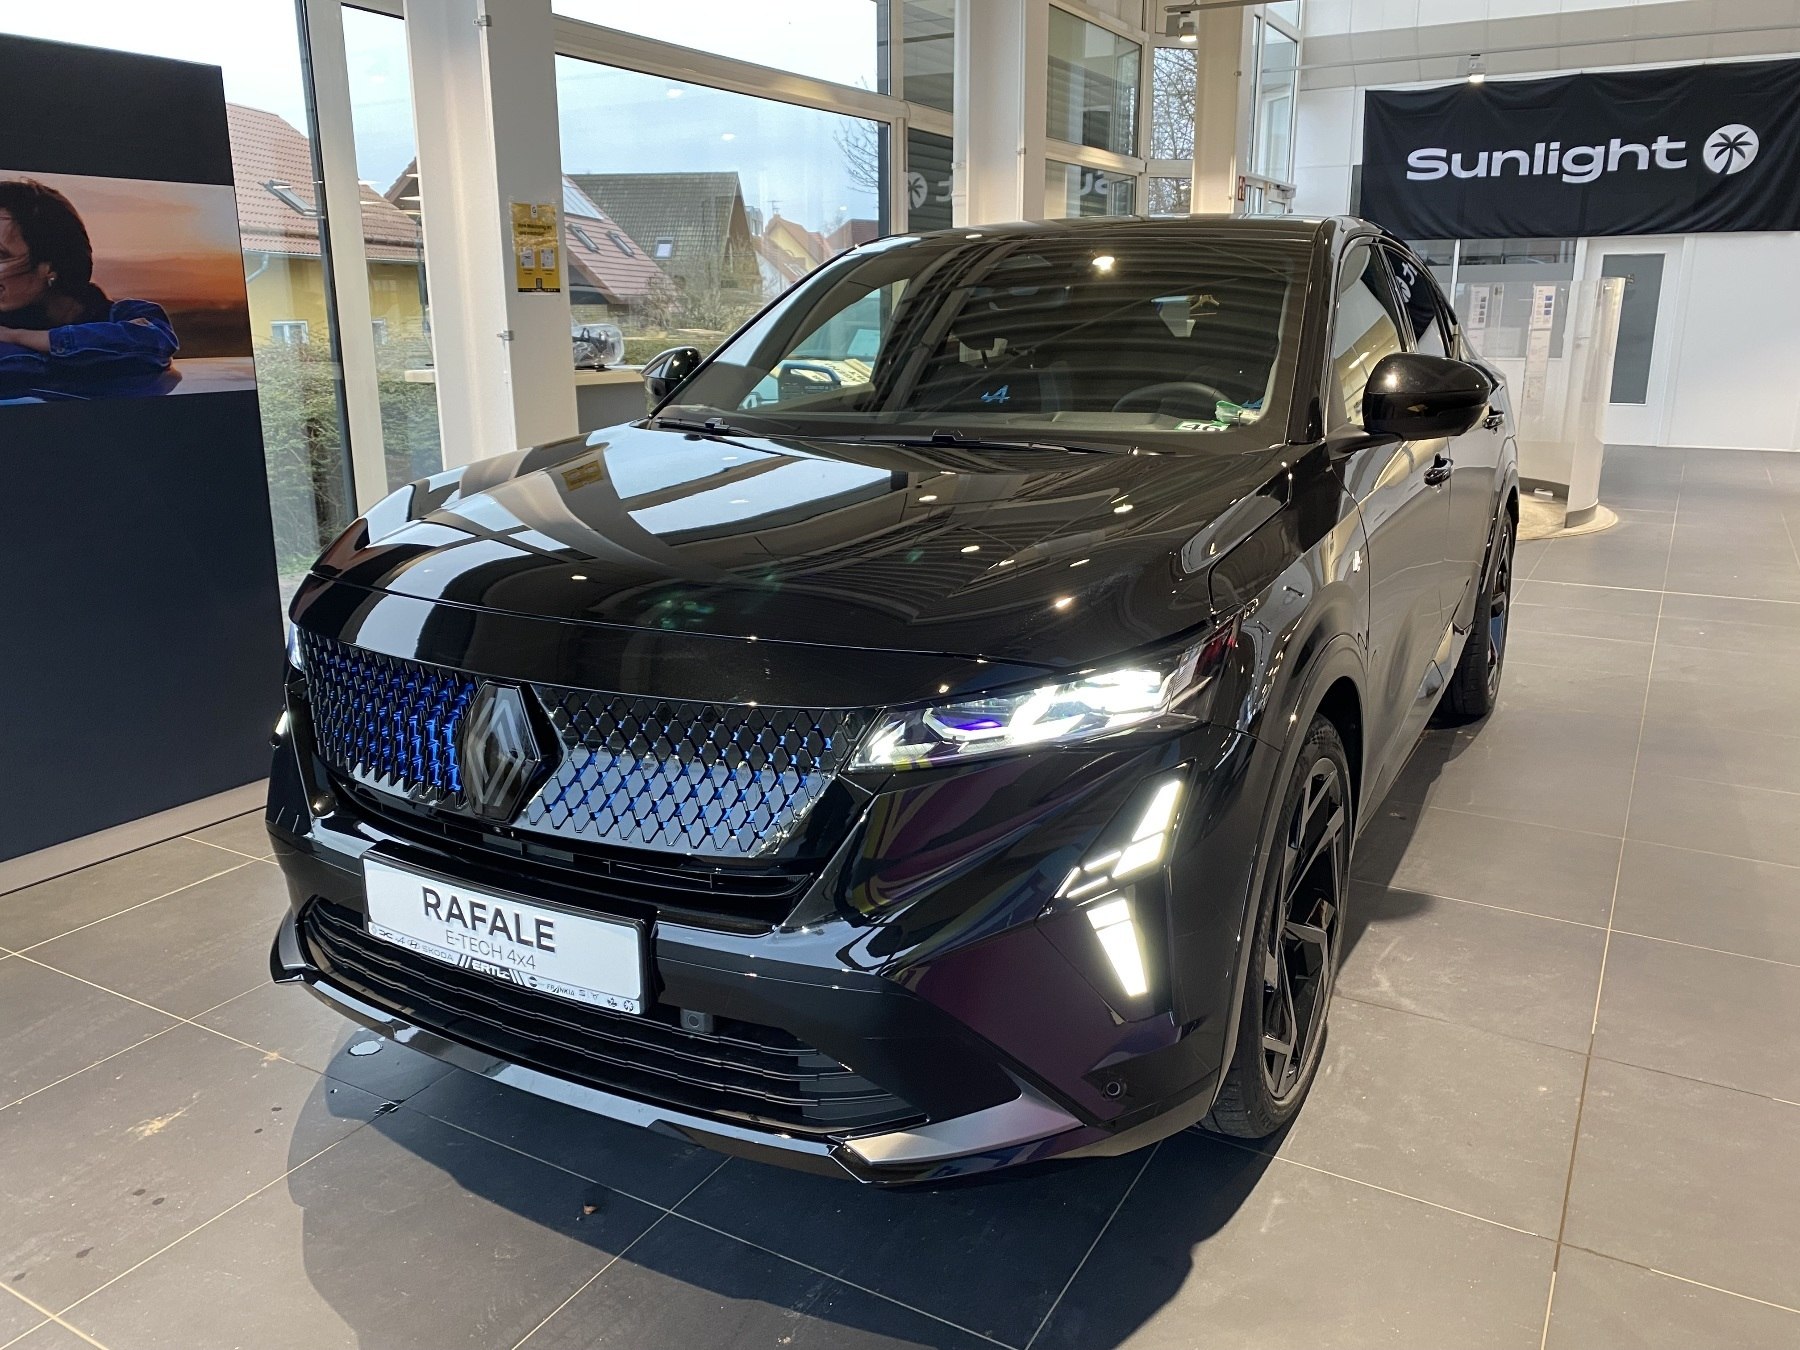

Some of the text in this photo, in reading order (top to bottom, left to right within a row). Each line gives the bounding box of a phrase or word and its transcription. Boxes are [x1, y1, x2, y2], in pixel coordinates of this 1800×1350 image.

[1406, 135, 1688, 184] Sunlight
[421, 885, 556, 953] RAFALE
[445, 929, 536, 970] E-TECH 4x4
